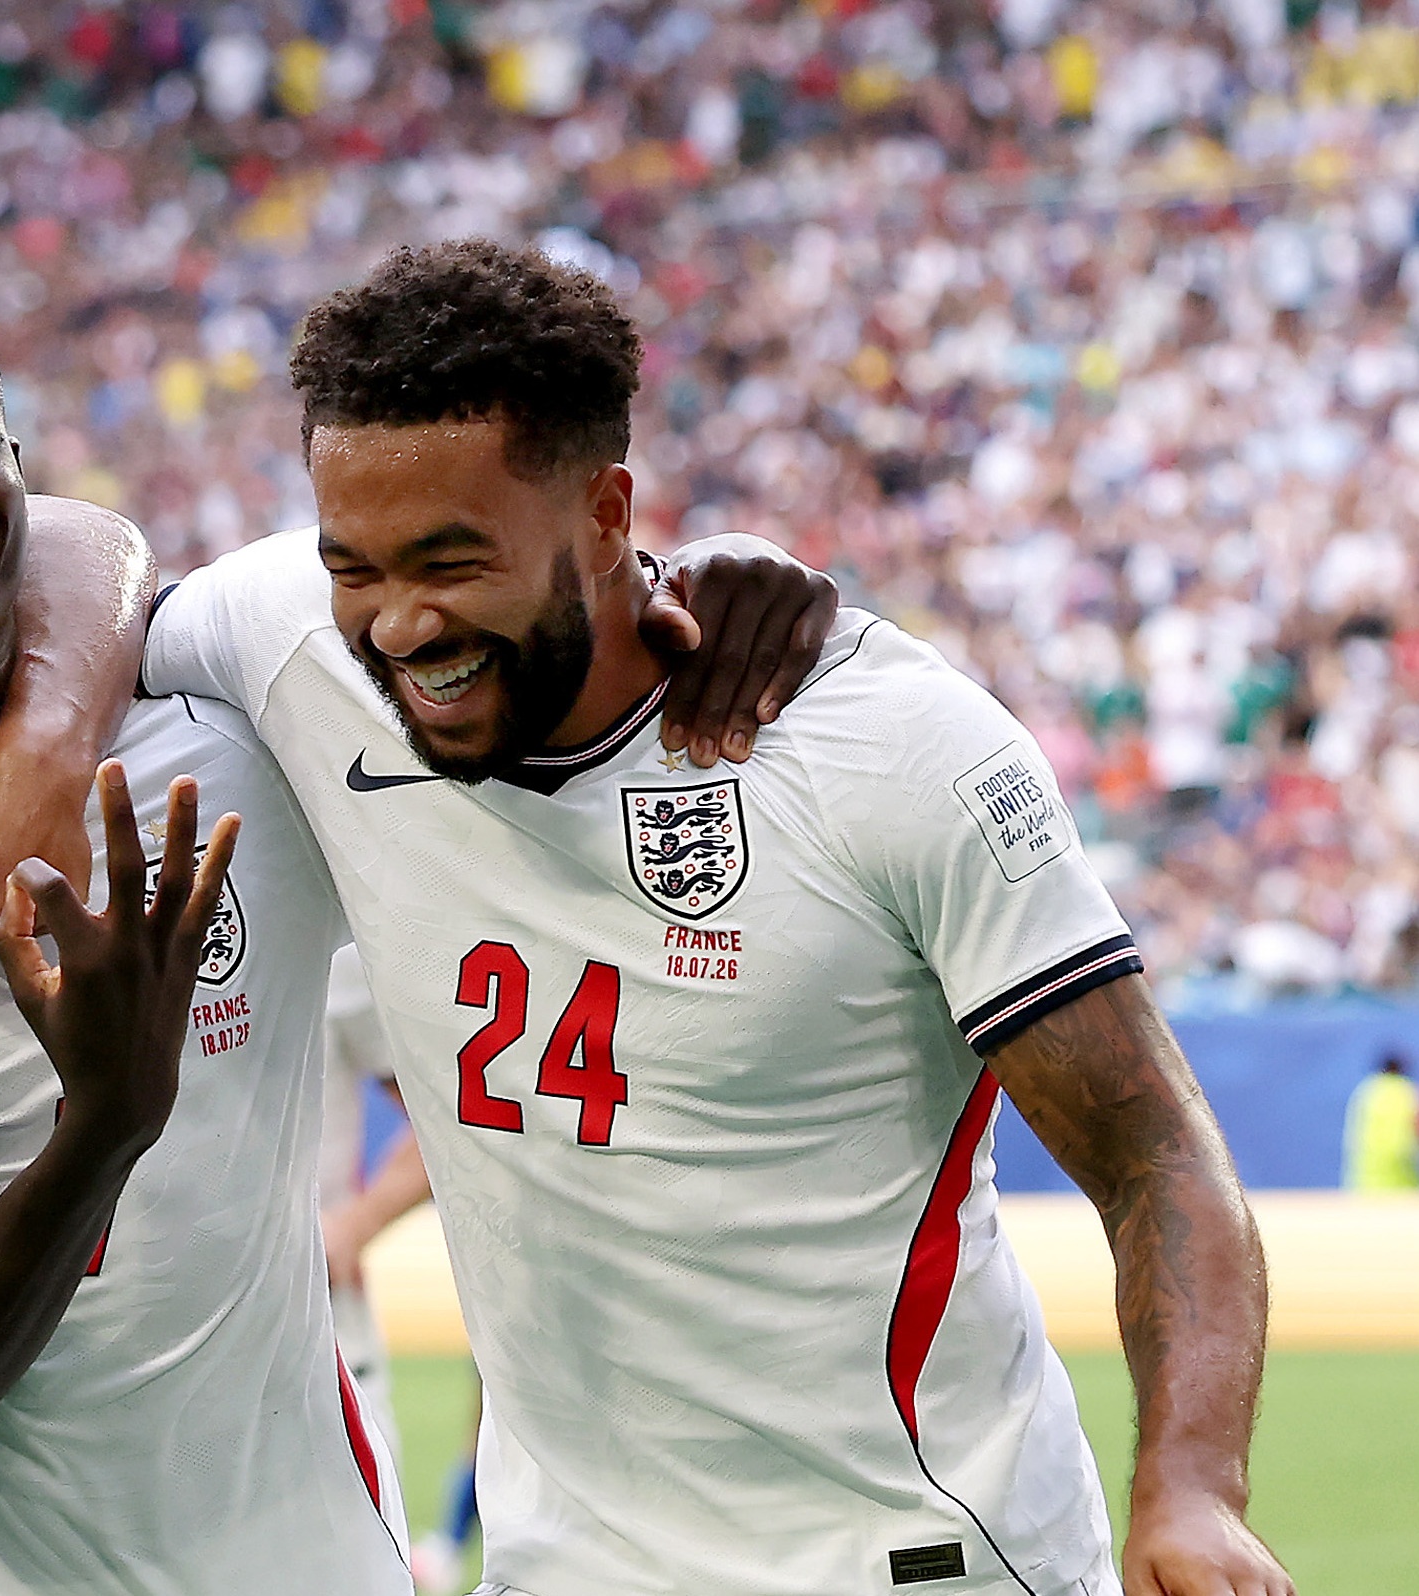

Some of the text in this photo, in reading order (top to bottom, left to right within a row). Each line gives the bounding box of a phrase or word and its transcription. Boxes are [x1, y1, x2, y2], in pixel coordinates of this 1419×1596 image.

[974, 759, 1030, 802] FOOTBALL
[986, 776, 1043, 825] UNITES
[998, 797, 1057, 850] the World
[1028, 832, 1053, 852] FIFA
[664, 926, 742, 952] FRANCE
[667, 955, 738, 980] 18.07.26
[192, 993, 251, 1030] FRANCE
[454, 939, 629, 1147] 24
